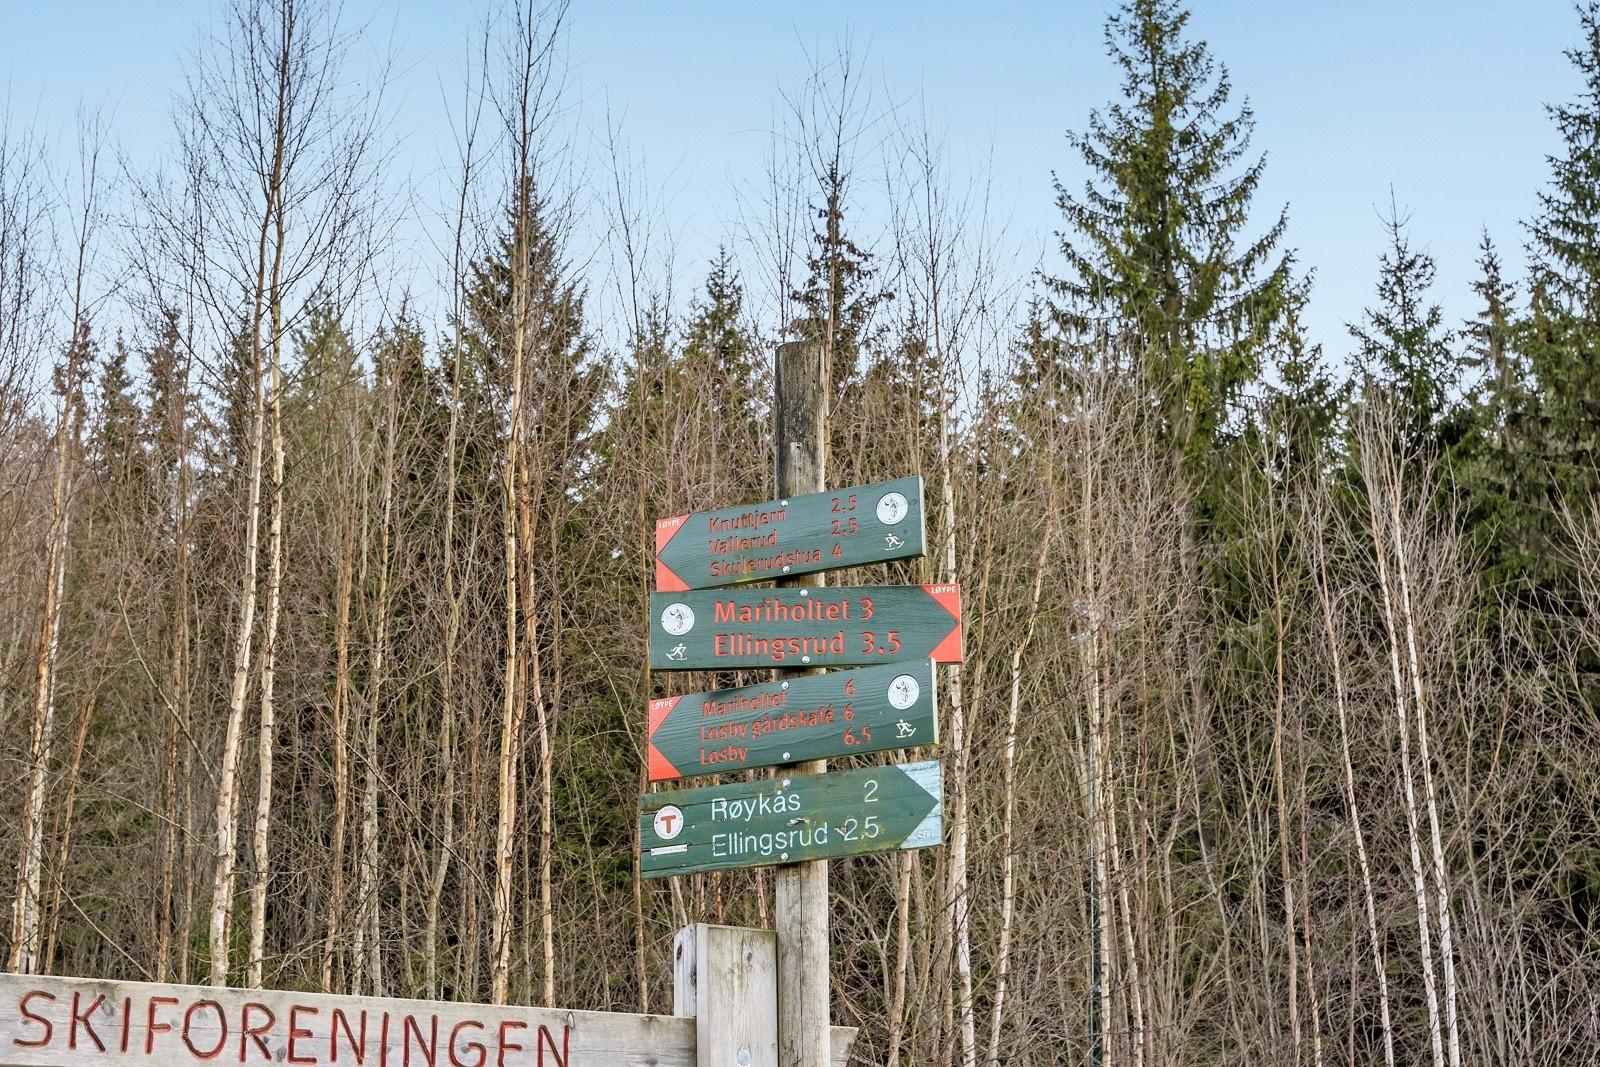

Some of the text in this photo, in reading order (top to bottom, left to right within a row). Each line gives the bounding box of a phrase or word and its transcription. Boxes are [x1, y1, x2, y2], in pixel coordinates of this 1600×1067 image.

[658, 518, 681, 528] LØYPE
[708, 495, 858, 533] Knuttjern 2,5
[708, 518, 858, 555] Vallerud 2,5
[710, 543, 842, 577] Skulerudstua 4
[931, 586, 956, 595] LØYPE
[714, 598, 874, 623] Mariholtet 3
[714, 631, 901, 661] Ellingsrud 3,5
[651, 700, 673, 710] LØYPE
[702, 679, 855, 717] Mariholtet 6
[701, 703, 854, 742] Losby gårdskafé 6
[701, 725, 871, 766] Losby 6,5
[711, 790, 800, 822] Røykås
[864, 780, 878, 802] 2
[660, 814, 677, 834] T
[712, 822, 828, 856] Ellingsrud
[12, 991, 570, 1067] SKIFORENINGEN
